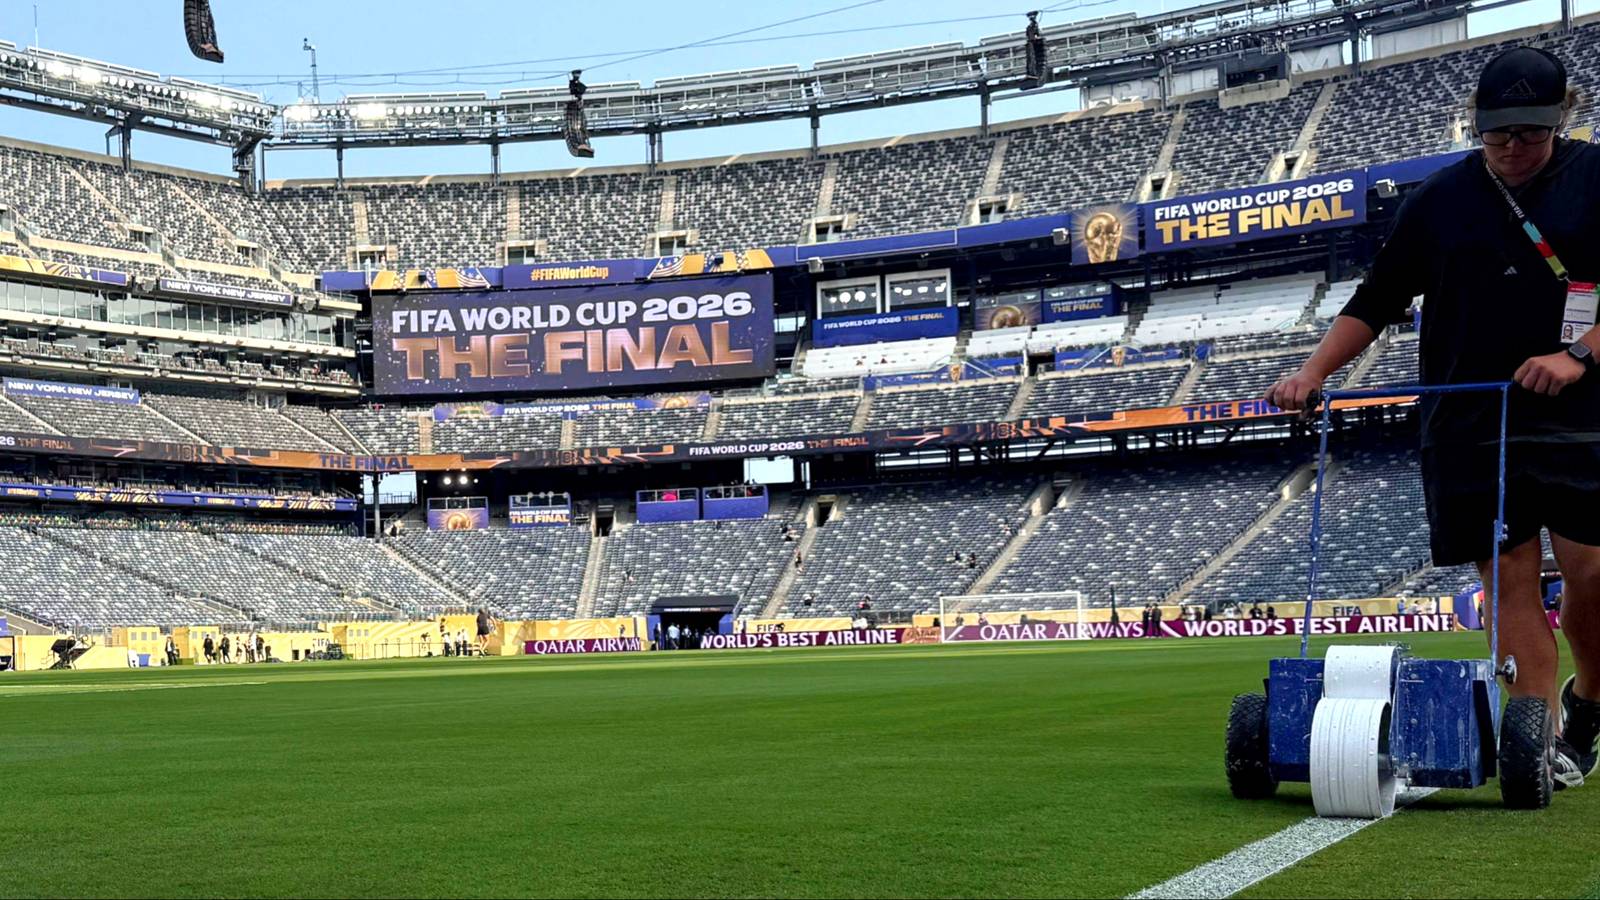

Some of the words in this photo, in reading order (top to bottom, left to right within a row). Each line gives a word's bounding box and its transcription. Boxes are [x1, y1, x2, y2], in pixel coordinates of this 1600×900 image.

[1155, 204, 1190, 221] FIFA
[1192, 195, 1254, 215] WORLD
[1255, 189, 1290, 206] CUP
[1292, 179, 1354, 201] 2026
[1155, 212, 1231, 244] THE
[1238, 195, 1355, 234] FINAL
[531, 266, 609, 280] #FIFAWorldCup
[166, 281, 191, 292] NEW
[192, 284, 221, 295] YORK
[222, 288, 246, 299] NEW
[247, 290, 286, 302] JERSEY
[392, 309, 457, 333] FIFA
[460, 304, 570, 332] WORLD
[576, 301, 637, 326] CUP
[642, 292, 752, 322] 2026
[839, 320, 863, 329] WORLD
[920, 313, 944, 321] FINAL
[392, 333, 530, 380] THE
[544, 320, 753, 375] FINAL
[8, 381, 34, 390] NEW
[36, 383, 67, 394] YORK
[68, 386, 93, 396] NEW
[94, 389, 135, 400] JERSEY
[520, 405, 547, 413] WORLD
[611, 402, 637, 410] FINAL
[1182, 403, 1232, 421] THE
[689, 447, 711, 456] FIFA
[711, 445, 747, 455] WORLD
[748, 444, 768, 453] CUP
[769, 441, 805, 451] 2026
[807, 440, 832, 449] THE
[833, 437, 869, 447] FINAL
[320, 454, 352, 468] THE
[355, 455, 414, 469] FINAL
[511, 515, 534, 523] THE
[534, 514, 570, 523] FINAL
[1332, 606, 1362, 617] FIFA
[980, 624, 1047, 641] QATAR
[1184, 618, 1286, 637] WORLD'S
[1357, 614, 1453, 634] AIRLINE
[534, 639, 585, 654] QATAR
[700, 632, 773, 649] WORLD'S
[777, 631, 819, 647] BEST
[825, 629, 897, 646] AIRLINE
